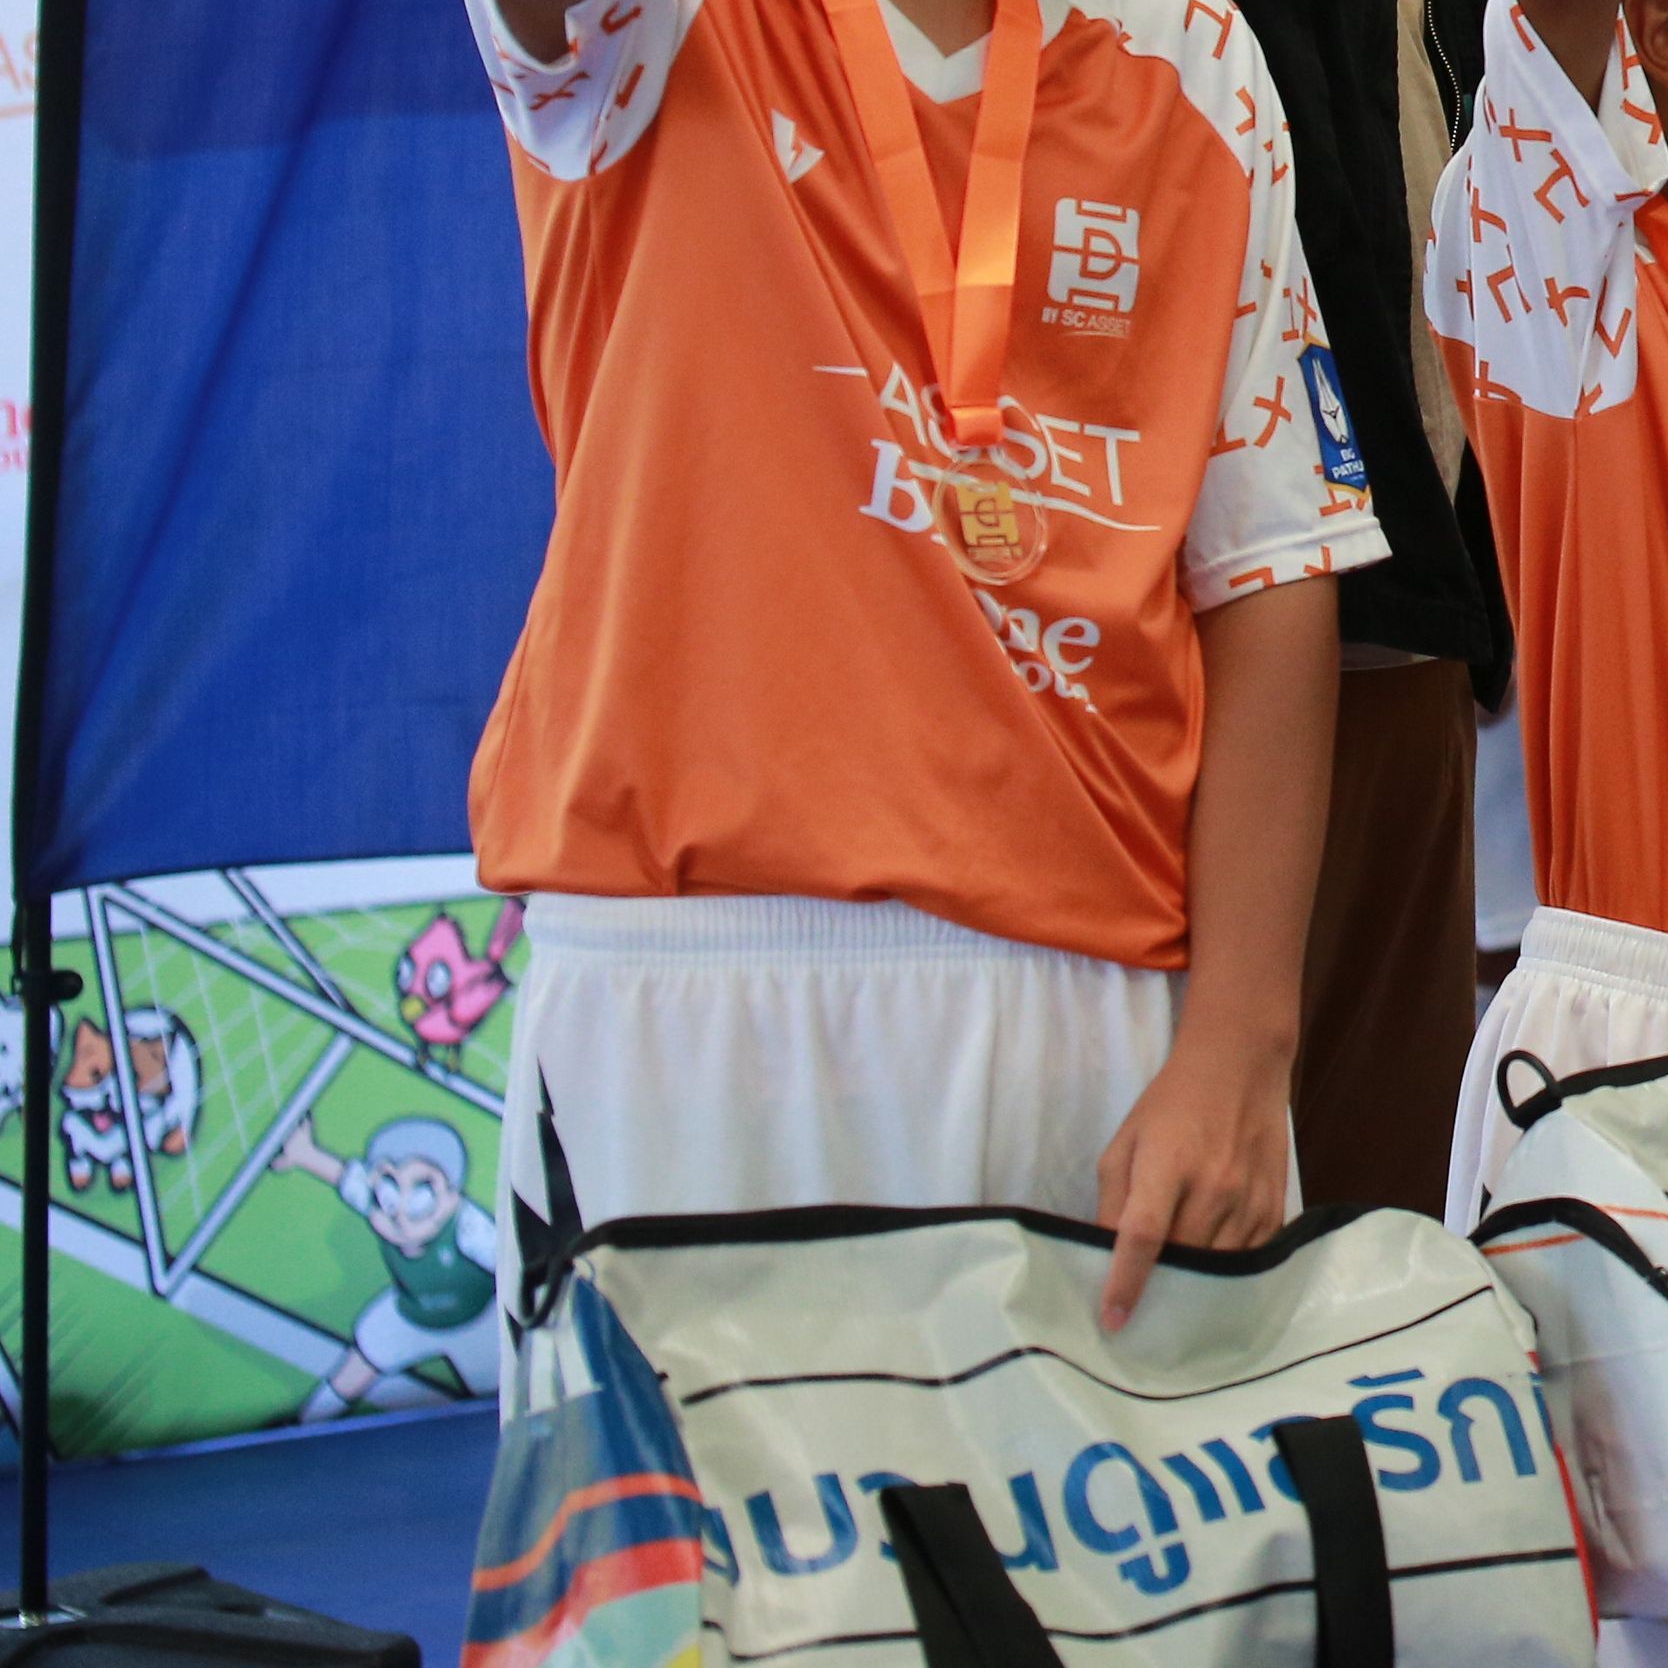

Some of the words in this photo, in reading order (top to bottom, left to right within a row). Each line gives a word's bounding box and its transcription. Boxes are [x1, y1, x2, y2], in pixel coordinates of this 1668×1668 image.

[1061, 309, 1087, 328] SC
[1087, 315, 1131, 333] ASSET
[1331, 459, 1365, 480] PATHU
